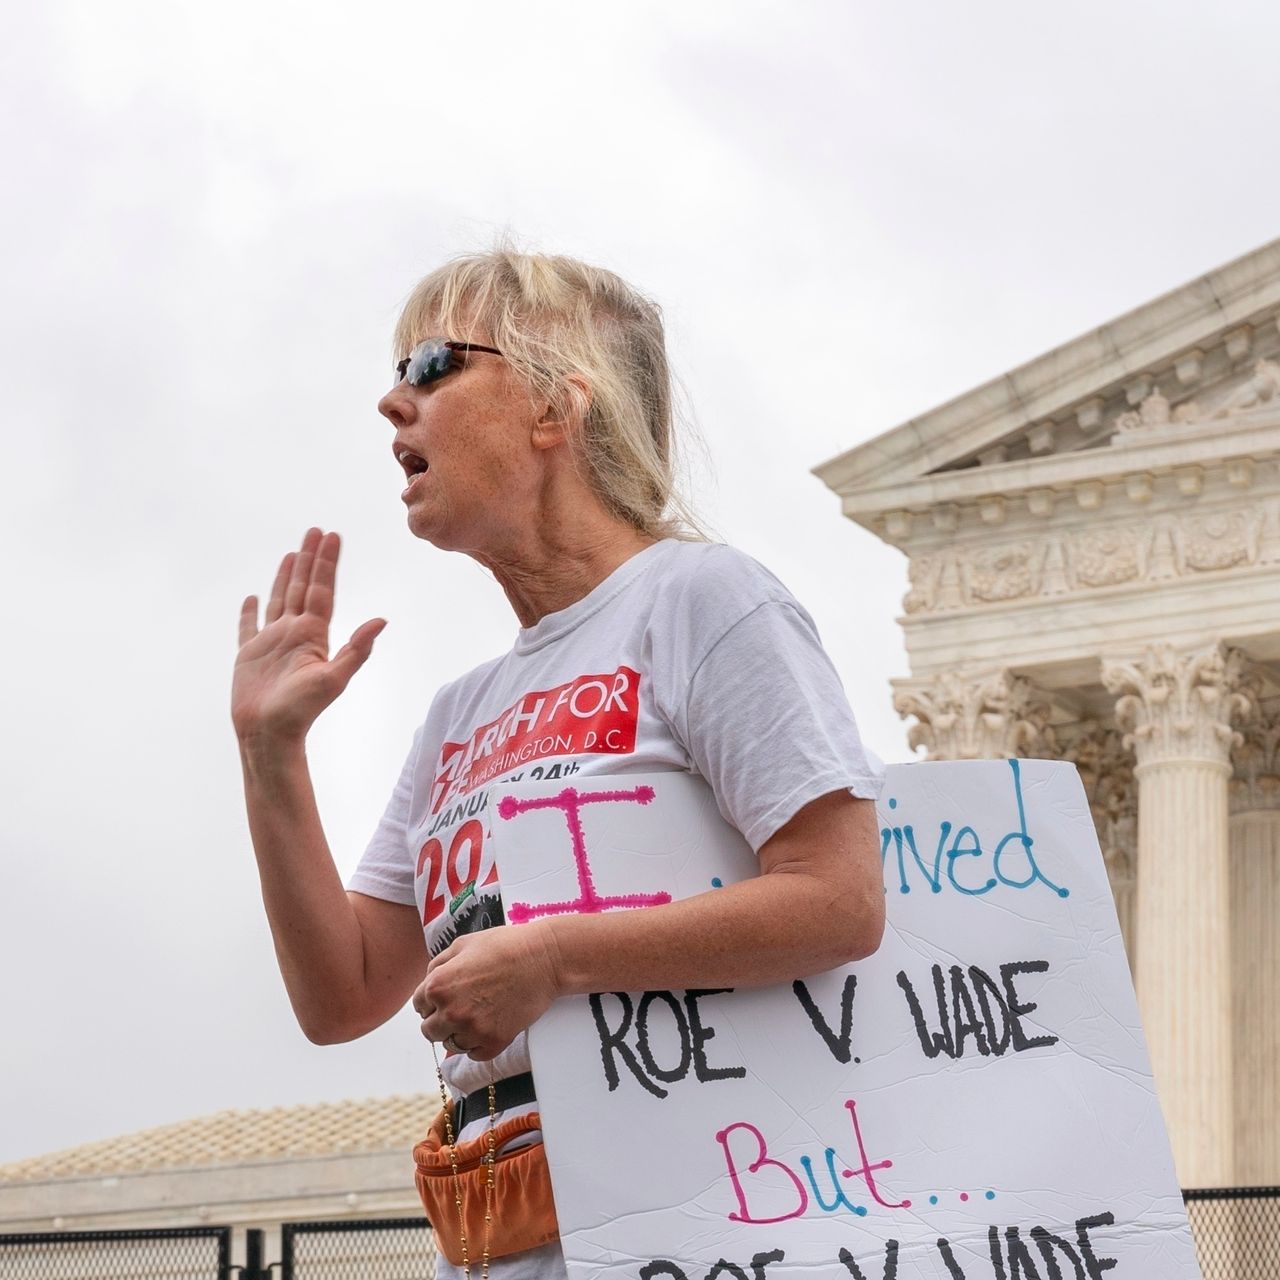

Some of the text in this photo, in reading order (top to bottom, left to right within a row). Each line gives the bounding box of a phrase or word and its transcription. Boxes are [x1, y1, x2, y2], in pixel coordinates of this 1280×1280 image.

[547, 672, 630, 722] FOR
[583, 729, 627, 750] D.C.
[416, 818, 499, 927] 20
[497, 758, 1070, 925] I ived
[588, 960, 1059, 1099] ROE V. WADE
